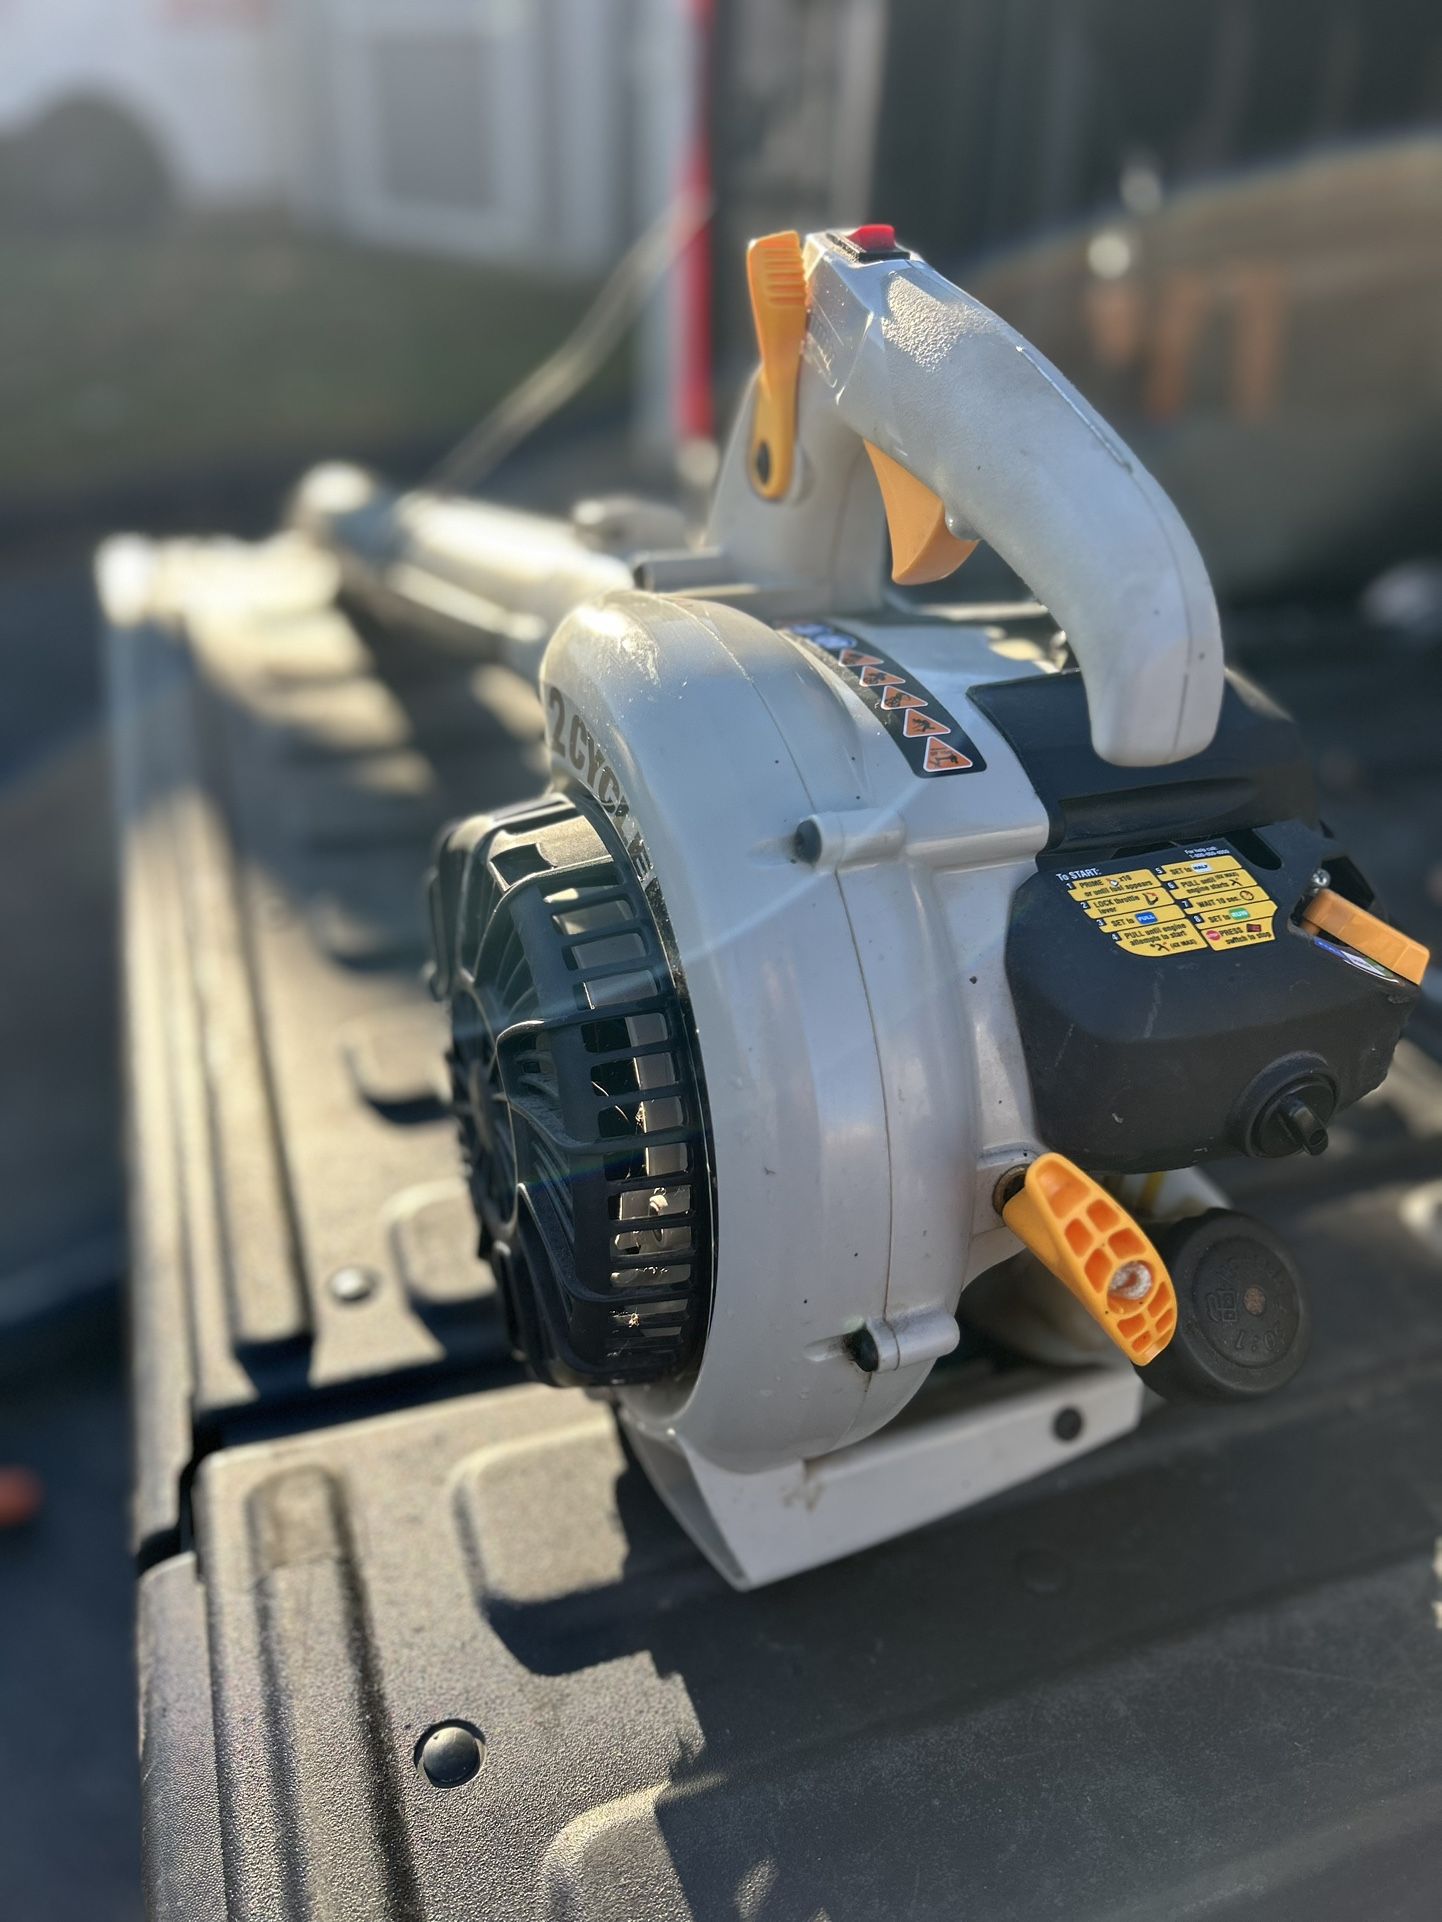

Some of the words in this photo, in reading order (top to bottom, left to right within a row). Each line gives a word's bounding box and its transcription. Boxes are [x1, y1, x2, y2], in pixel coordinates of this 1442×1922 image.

[548, 685, 567, 757] 2
[1056, 873, 1069, 881] To
[1068, 867, 1102, 880] START:
[1155, 867, 1163, 875] 5
[1079, 880, 1104, 889] PRIME
[1111, 884, 1124, 893] fuel
[1125, 880, 1153, 890] appears
[1181, 879, 1200, 888] PULL
[1200, 876, 1216, 884] until
[1186, 886, 1209, 894] engine
[1210, 882, 1229, 890] starts
[1080, 901, 1088, 909] 2
[1093, 900, 1113, 908] LOCK
[1114, 894, 1140, 904] throttle
[1197, 899, 1216, 908] WAIT
[1098, 907, 1117, 915] lever
[1208, 915, 1222, 923] SET
[1231, 910, 1248, 918] RUN
[1111, 919, 1126, 927] SET
[1137, 914, 1155, 922] FULL
[1124, 930, 1144, 939] PULL
[1145, 927, 1161, 935] until
[1162, 923, 1186, 932] engine
[1219, 926, 1243, 936] PRESS
[1225, 935, 1248, 944] switch
[1256, 931, 1272, 939] stop
[1130, 936, 1161, 946] attempts
[1170, 930, 1186, 938] start
